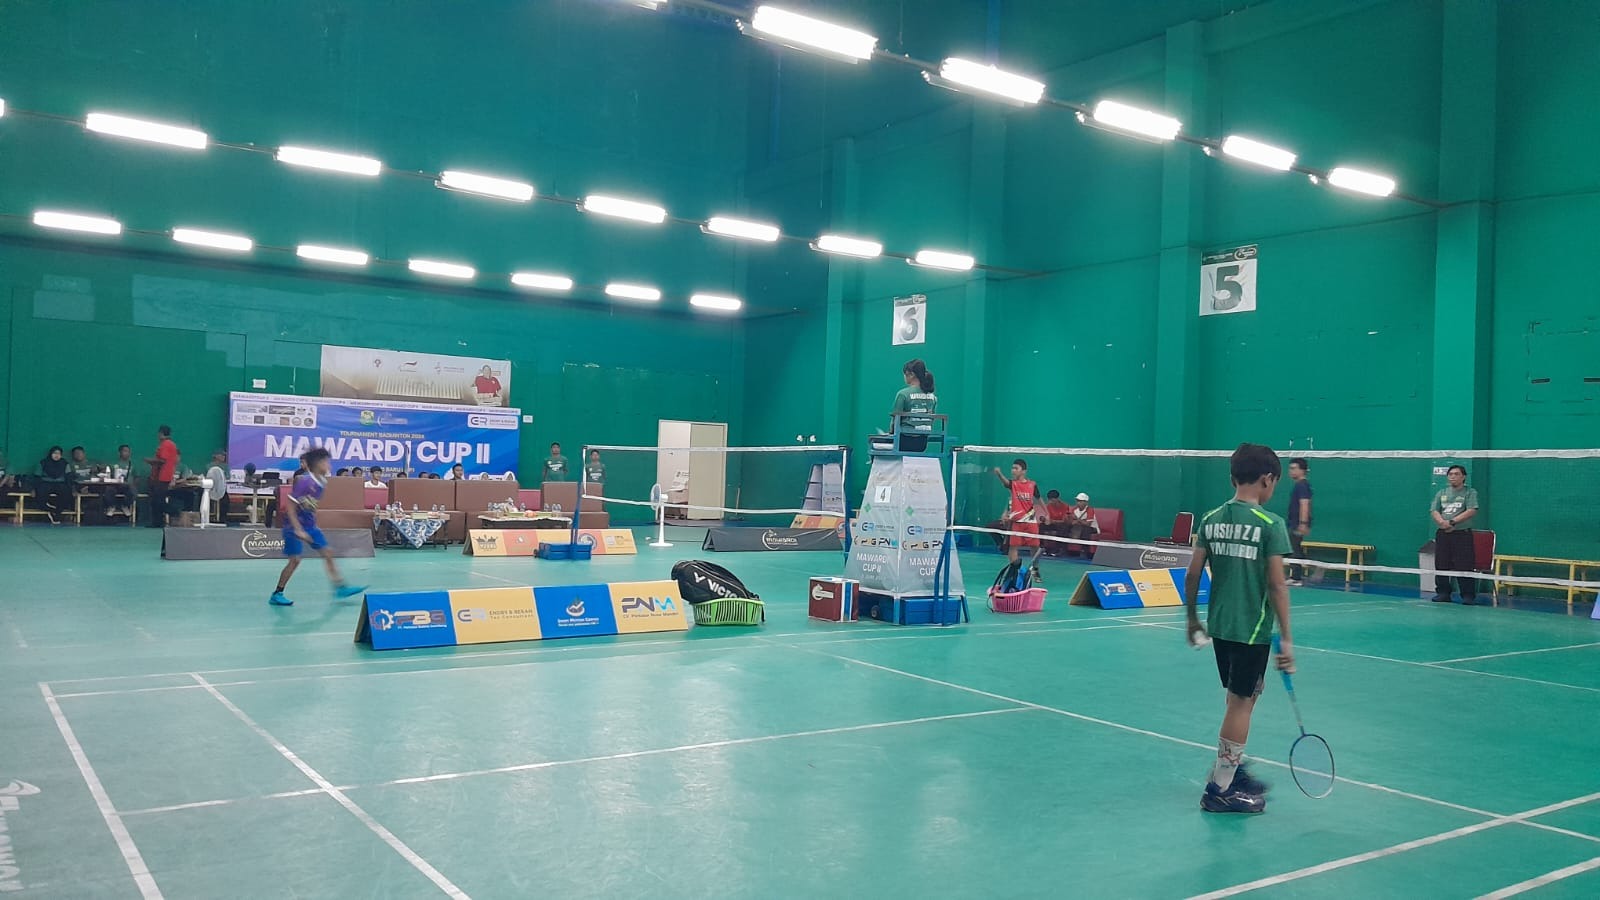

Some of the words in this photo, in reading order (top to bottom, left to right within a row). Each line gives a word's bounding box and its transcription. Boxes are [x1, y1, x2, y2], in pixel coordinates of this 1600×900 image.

[1213, 264, 1243, 312] 5
[901, 306, 919, 341] 6
[339, 430, 378, 438] TOURNAMENT
[416, 441, 472, 464] CUP
[476, 443, 490, 465] II
[880, 488, 886, 501] 4
[856, 552, 888, 564] MAWARDI
[863, 563, 877, 572] CUP
[707, 579, 738, 599] VICTO
